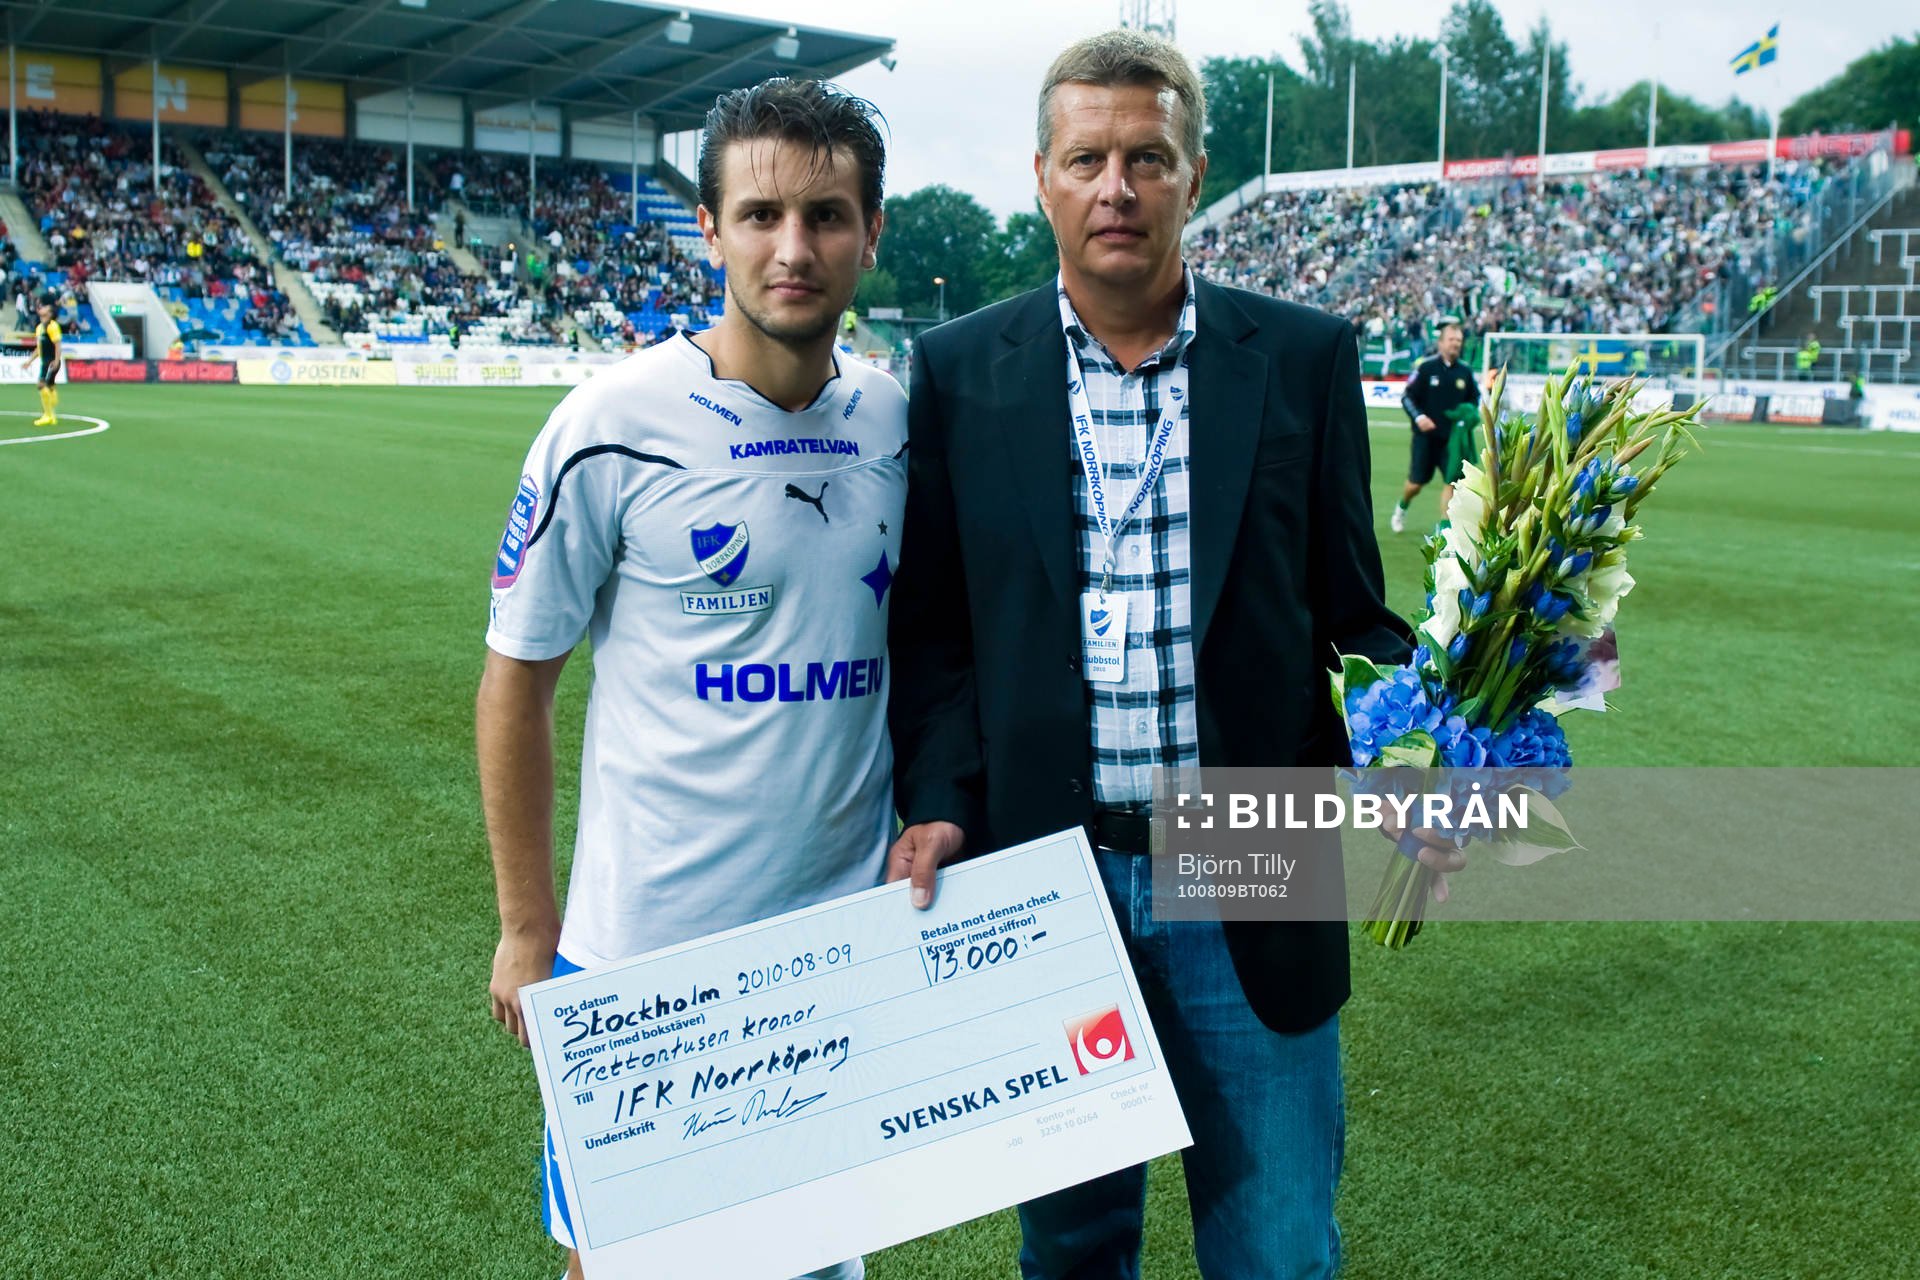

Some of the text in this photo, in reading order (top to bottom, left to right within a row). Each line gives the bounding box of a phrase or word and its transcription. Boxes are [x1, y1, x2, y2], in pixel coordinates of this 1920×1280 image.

[297, 365, 366, 379] POSTEN!
[689, 392, 742, 426] HOLMEN
[842, 387, 863, 420] HOLMEN
[729, 438, 859, 459] KAMRATELVAN
[1075, 414, 1109, 536] IFK NORRKÖPING
[1129, 418, 1174, 514] NORRKÖPING
[687, 591, 769, 610] FAMILJEN
[1083, 655, 1120, 665] lubbstol
[696, 656, 883, 702] HOLMEN
[921, 890, 1060, 941] Betala mot denna check
[926, 914, 1037, 956] Kronor (med siffror)
[563, 985, 720, 1048] Stockholm
[579, 994, 618, 1011] datum
[564, 1013, 706, 1062] Kronor (med bokstäver)
[742, 1004, 816, 1039] kronor
[614, 1080, 674, 1123] IFK
[691, 1036, 849, 1099] Norrköping
[1110, 1085, 1137, 1100] Check
[574, 1091, 593, 1105] Till
[880, 1086, 1001, 1140] SVENSKA
[1005, 1065, 1069, 1100] SPEL
[585, 1121, 656, 1149] Underskrift
[1036, 1110, 1064, 1126] Konto
